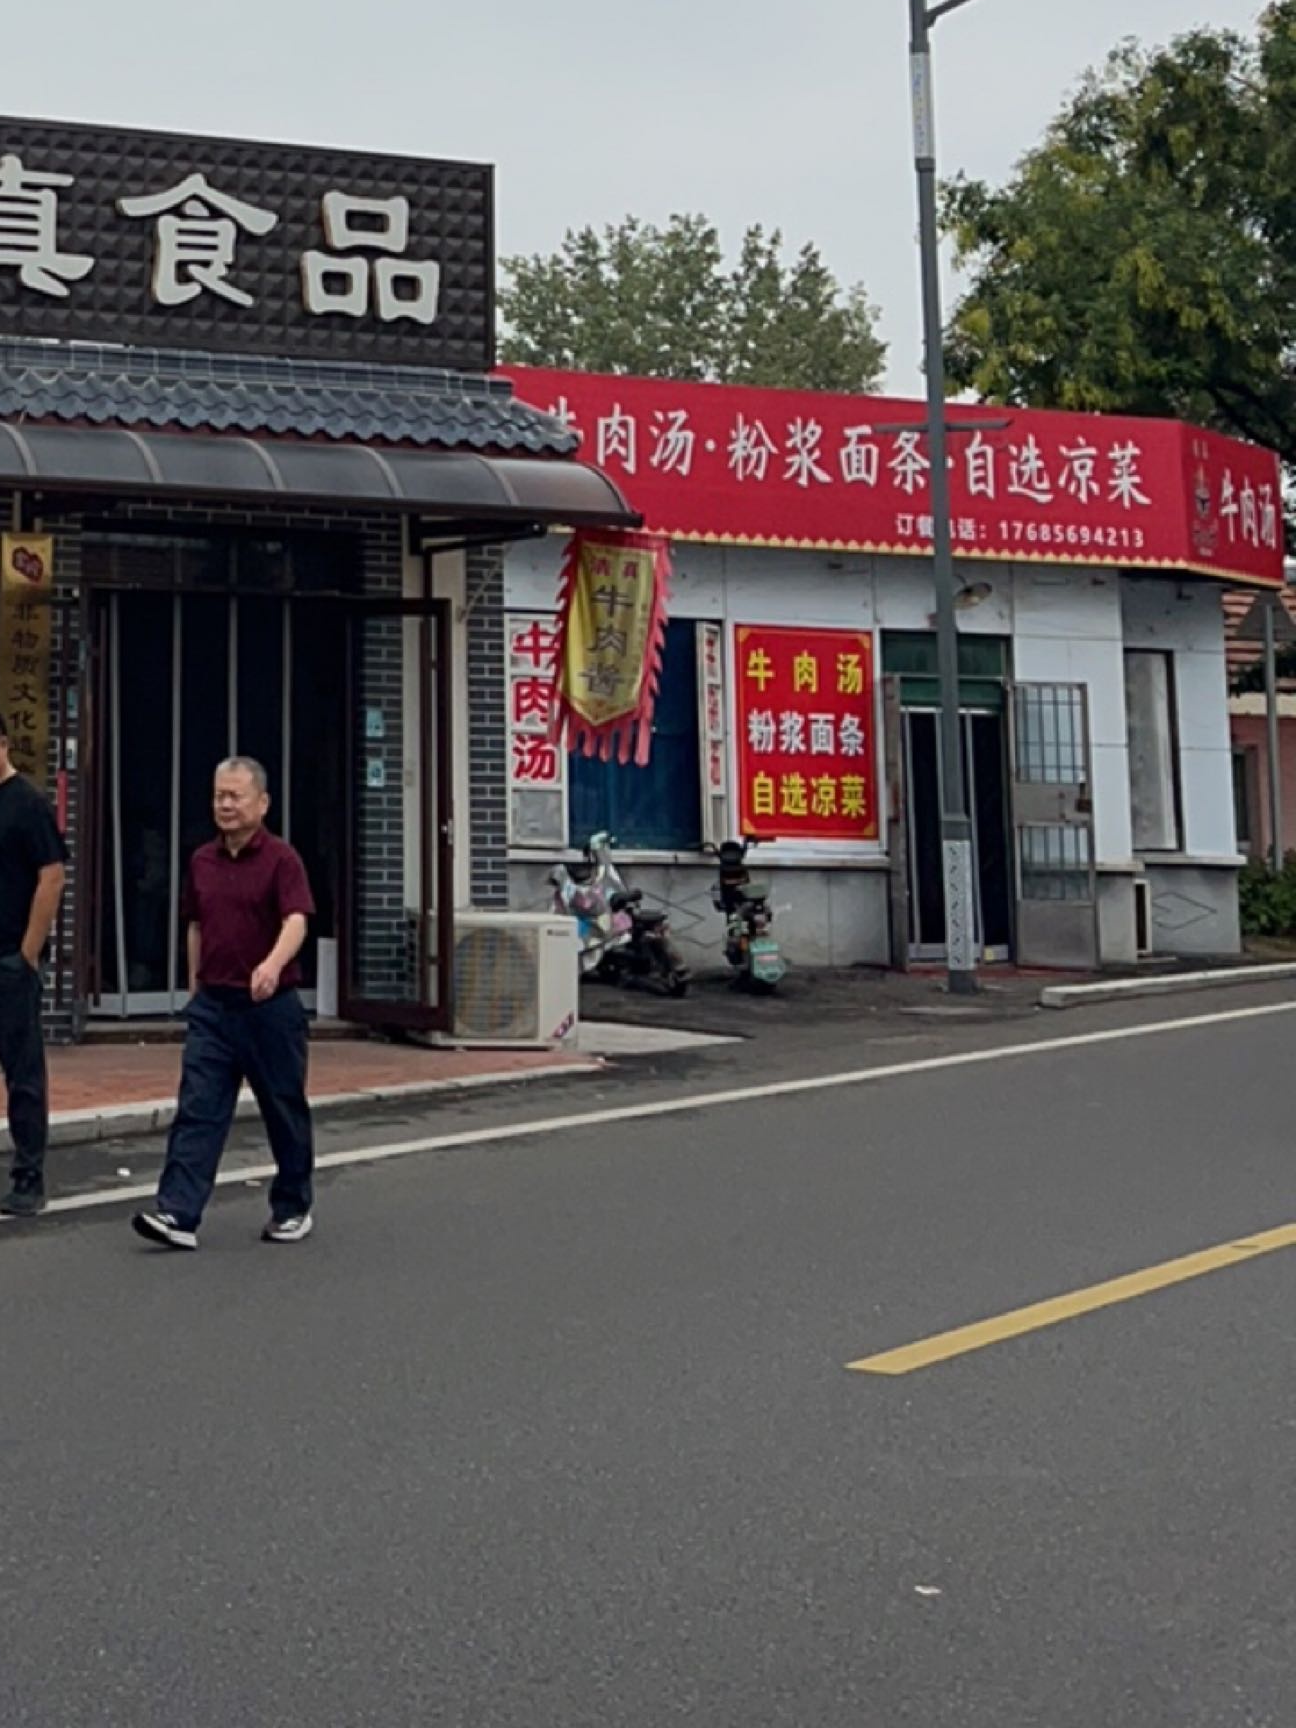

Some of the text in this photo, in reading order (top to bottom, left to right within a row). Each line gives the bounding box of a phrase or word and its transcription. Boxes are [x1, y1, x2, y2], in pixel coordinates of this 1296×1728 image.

[747, 647, 863, 694] 牛肉汤
[512, 621, 558, 779] 牛肉汤
[748, 707, 865, 757] 粉浆面条
[753, 771, 866, 818] 自选凉菜
